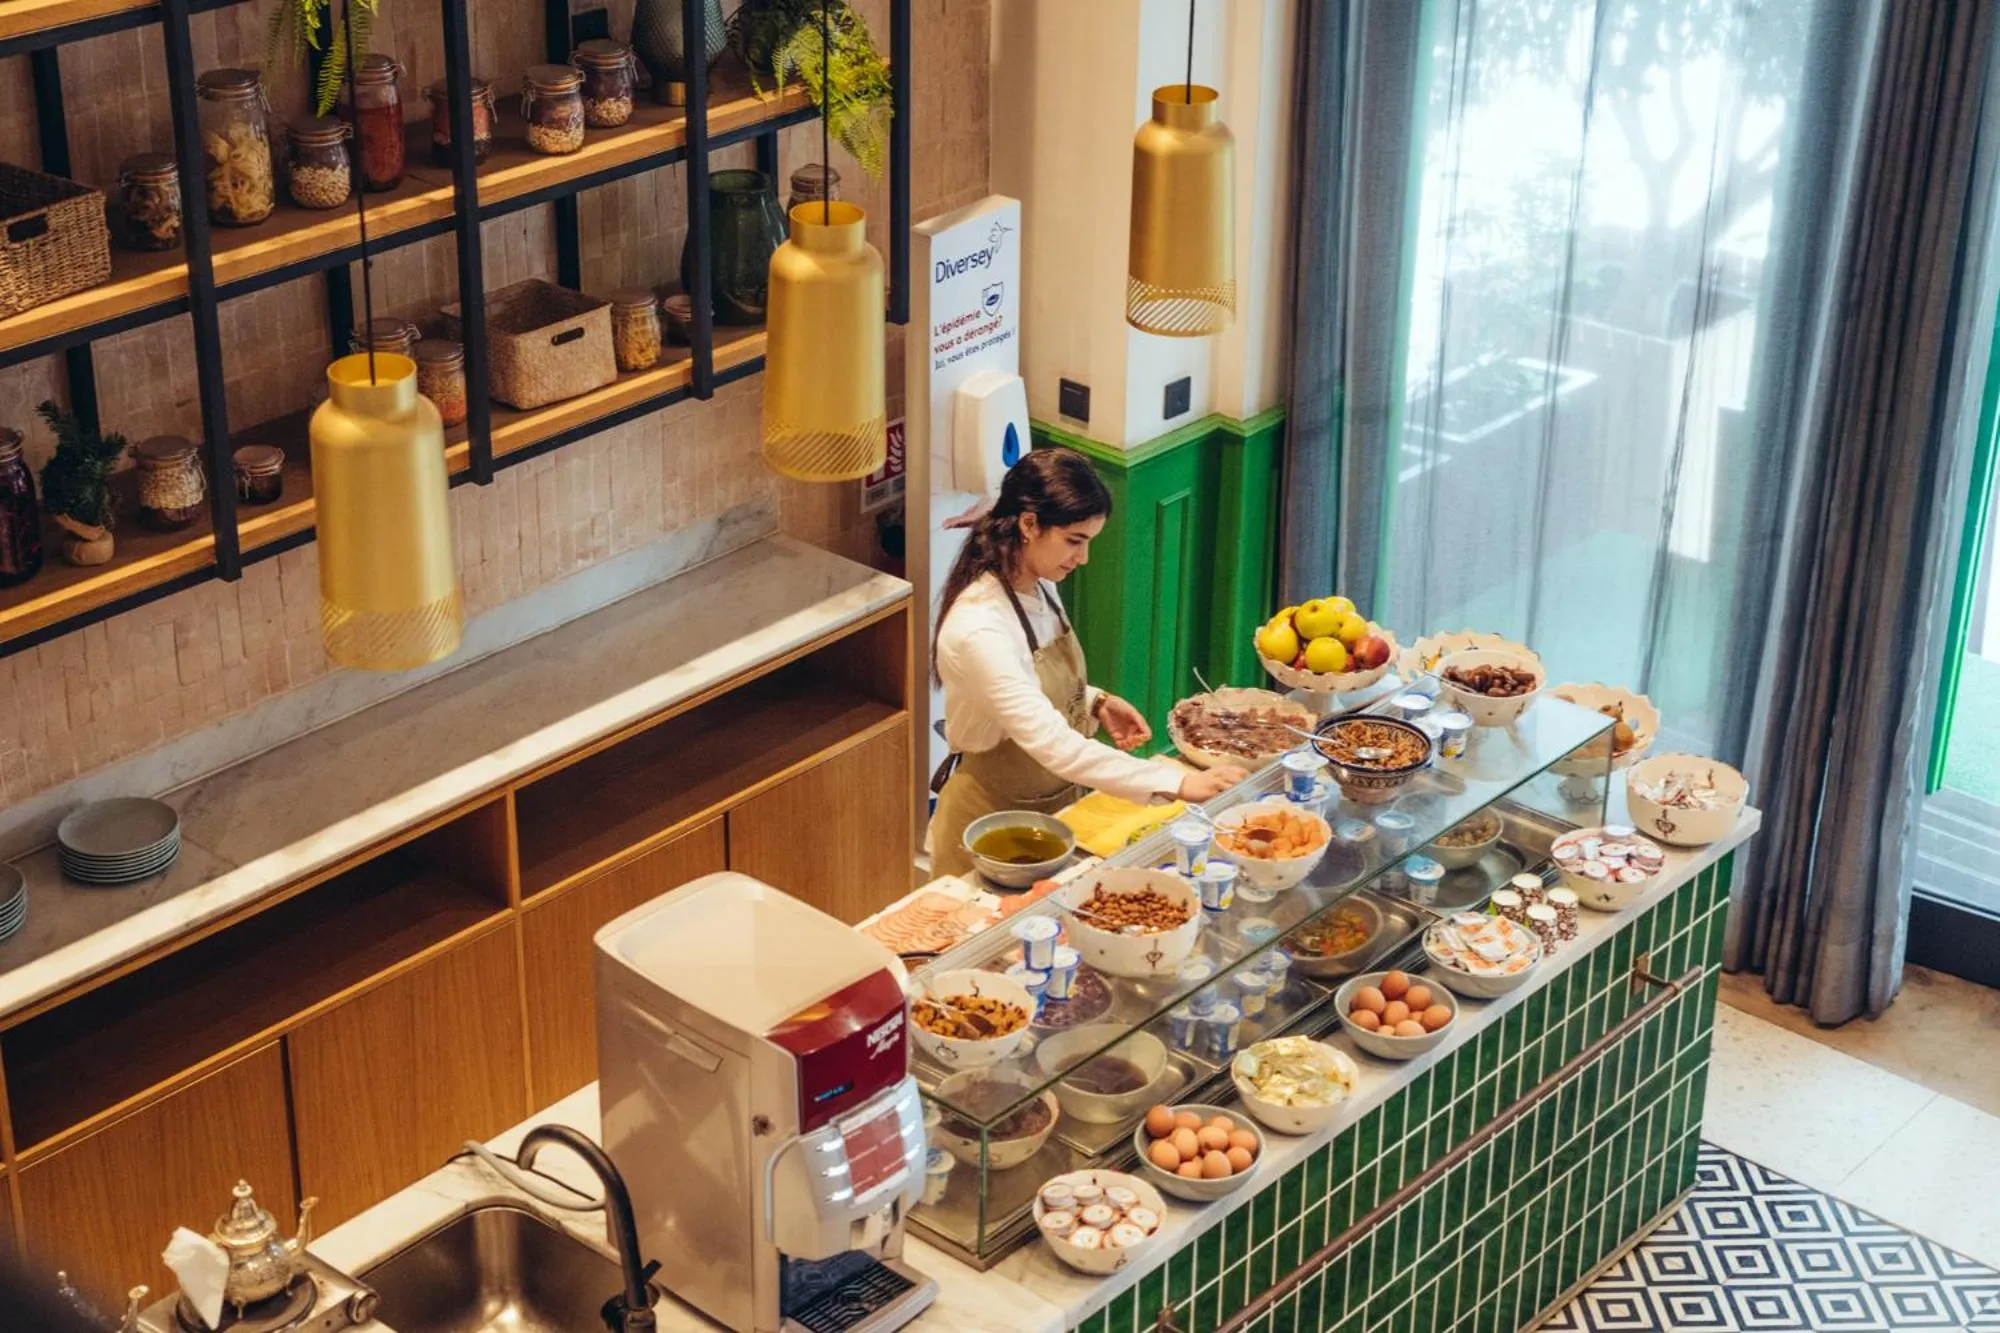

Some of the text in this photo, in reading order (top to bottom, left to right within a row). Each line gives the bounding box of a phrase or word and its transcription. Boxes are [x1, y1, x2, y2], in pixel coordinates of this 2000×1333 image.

[935, 246, 994, 283] Diversey
[934, 339, 954, 354] vous
[956, 336, 962, 345] a
